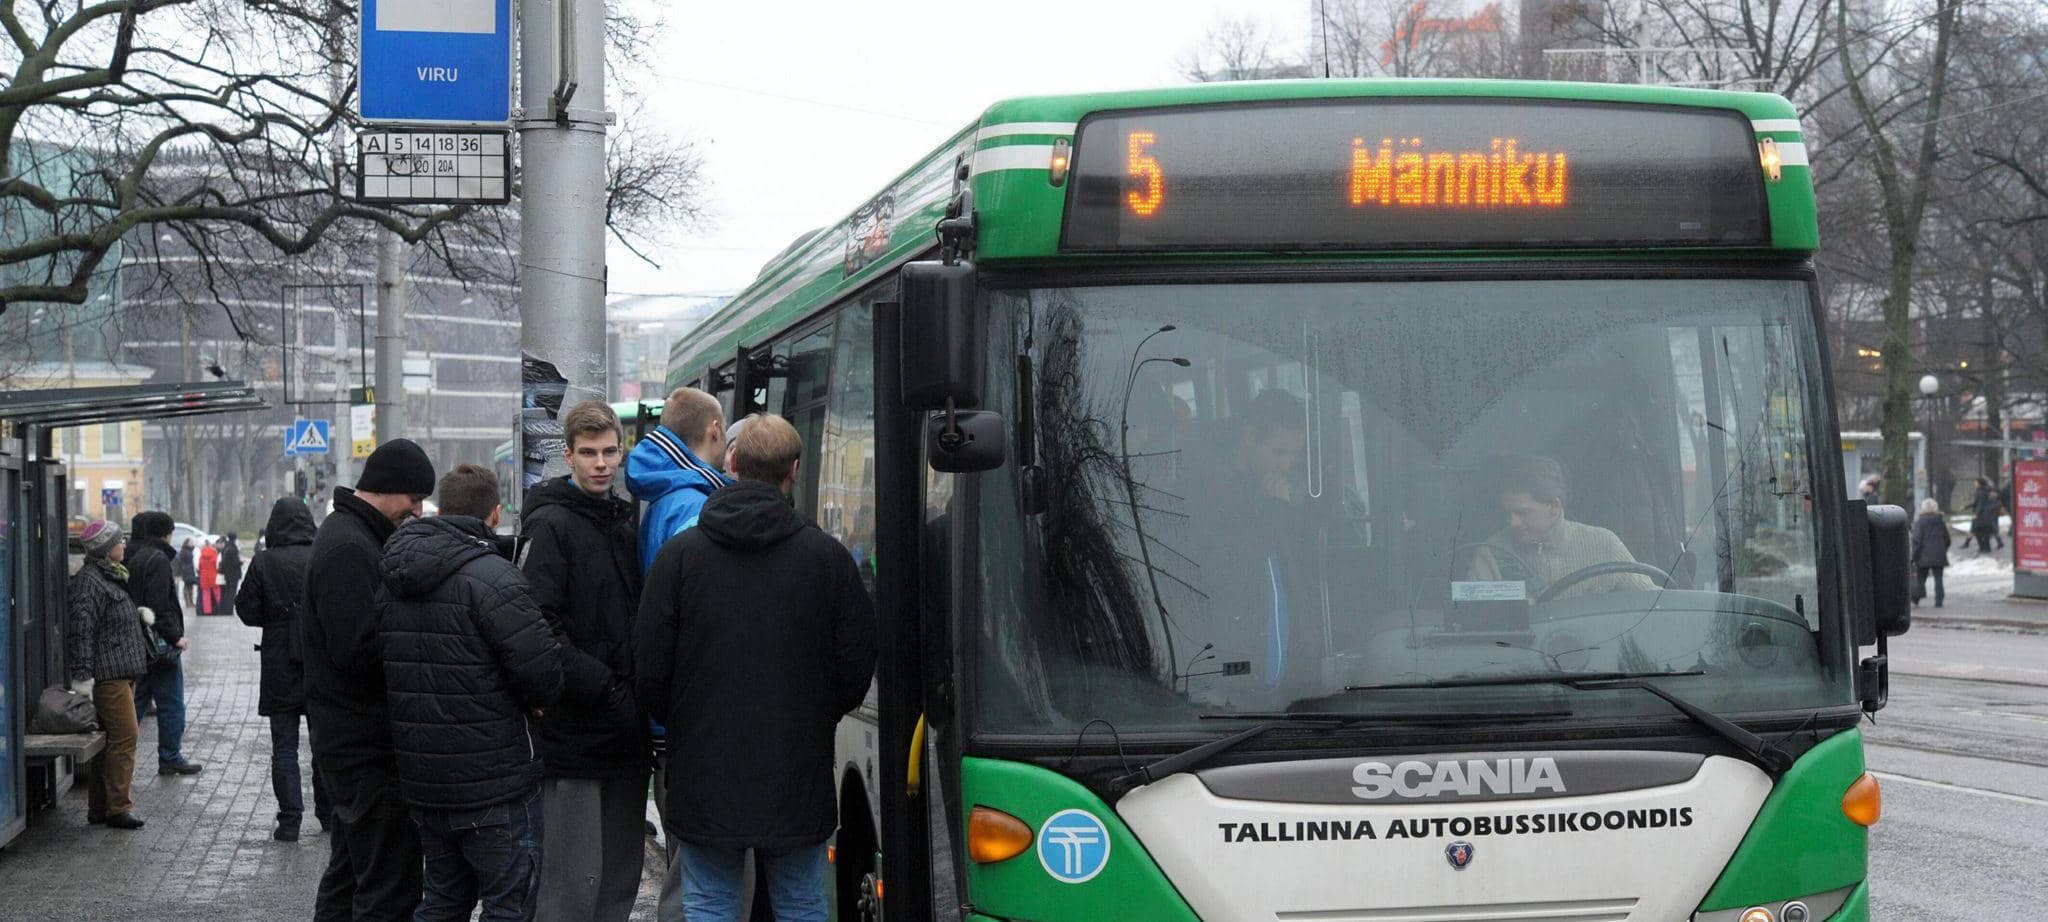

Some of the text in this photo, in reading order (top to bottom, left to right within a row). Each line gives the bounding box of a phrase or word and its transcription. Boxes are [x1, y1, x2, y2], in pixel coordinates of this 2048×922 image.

[417, 67, 458, 82] VIRU
[367, 136, 479, 151] A 5 14 18 36
[438, 160, 454, 172] 20A
[1127, 132, 1568, 216] 5 Männiku
[1351, 757, 1567, 800] SCANIA
[1218, 806, 1694, 843] TALLINNA AUTOBUSSIKOONDIS
